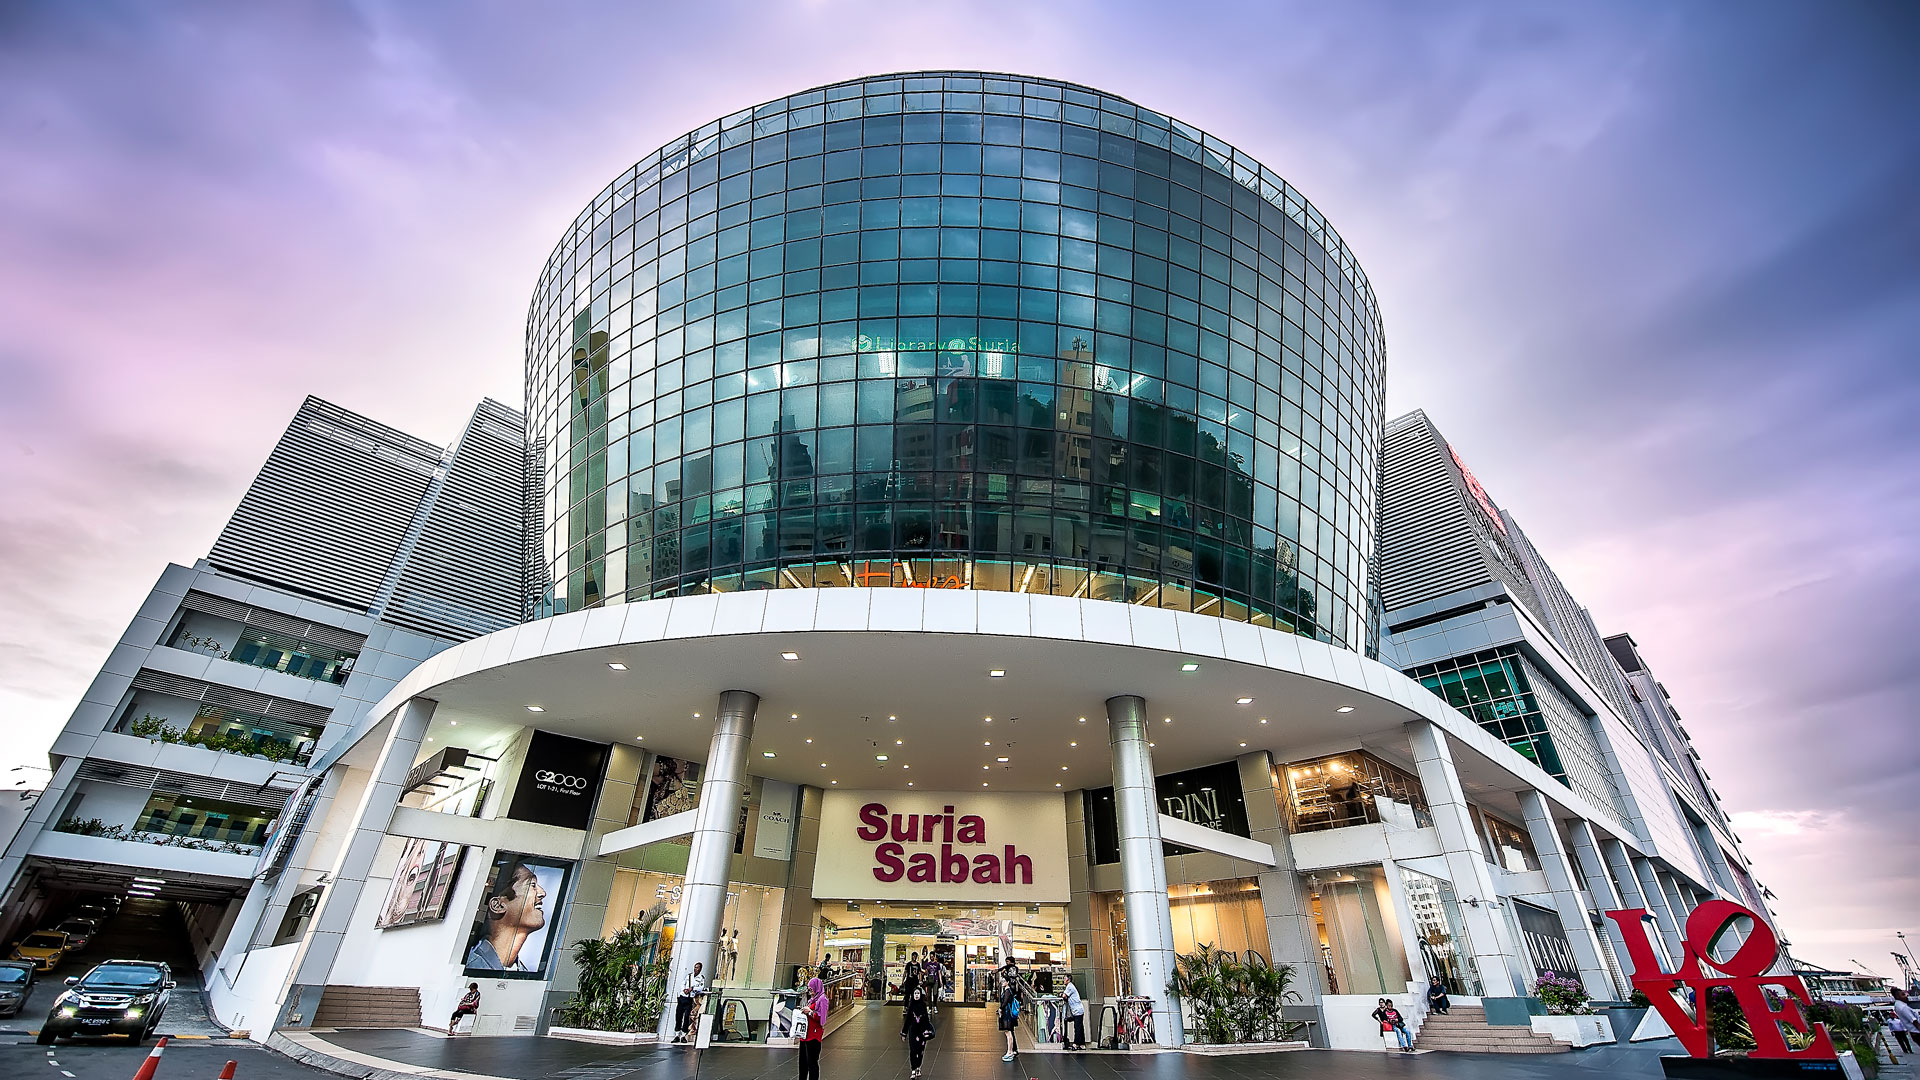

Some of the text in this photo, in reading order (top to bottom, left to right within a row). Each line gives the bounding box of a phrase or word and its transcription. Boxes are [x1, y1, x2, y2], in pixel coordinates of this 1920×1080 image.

[535, 769, 587, 789] G2000
[763, 814, 790, 824] COACH
[857, 802, 987, 844] Suria
[872, 842, 1033, 884] Sabah
[1523, 930, 1577, 974] MANGO
